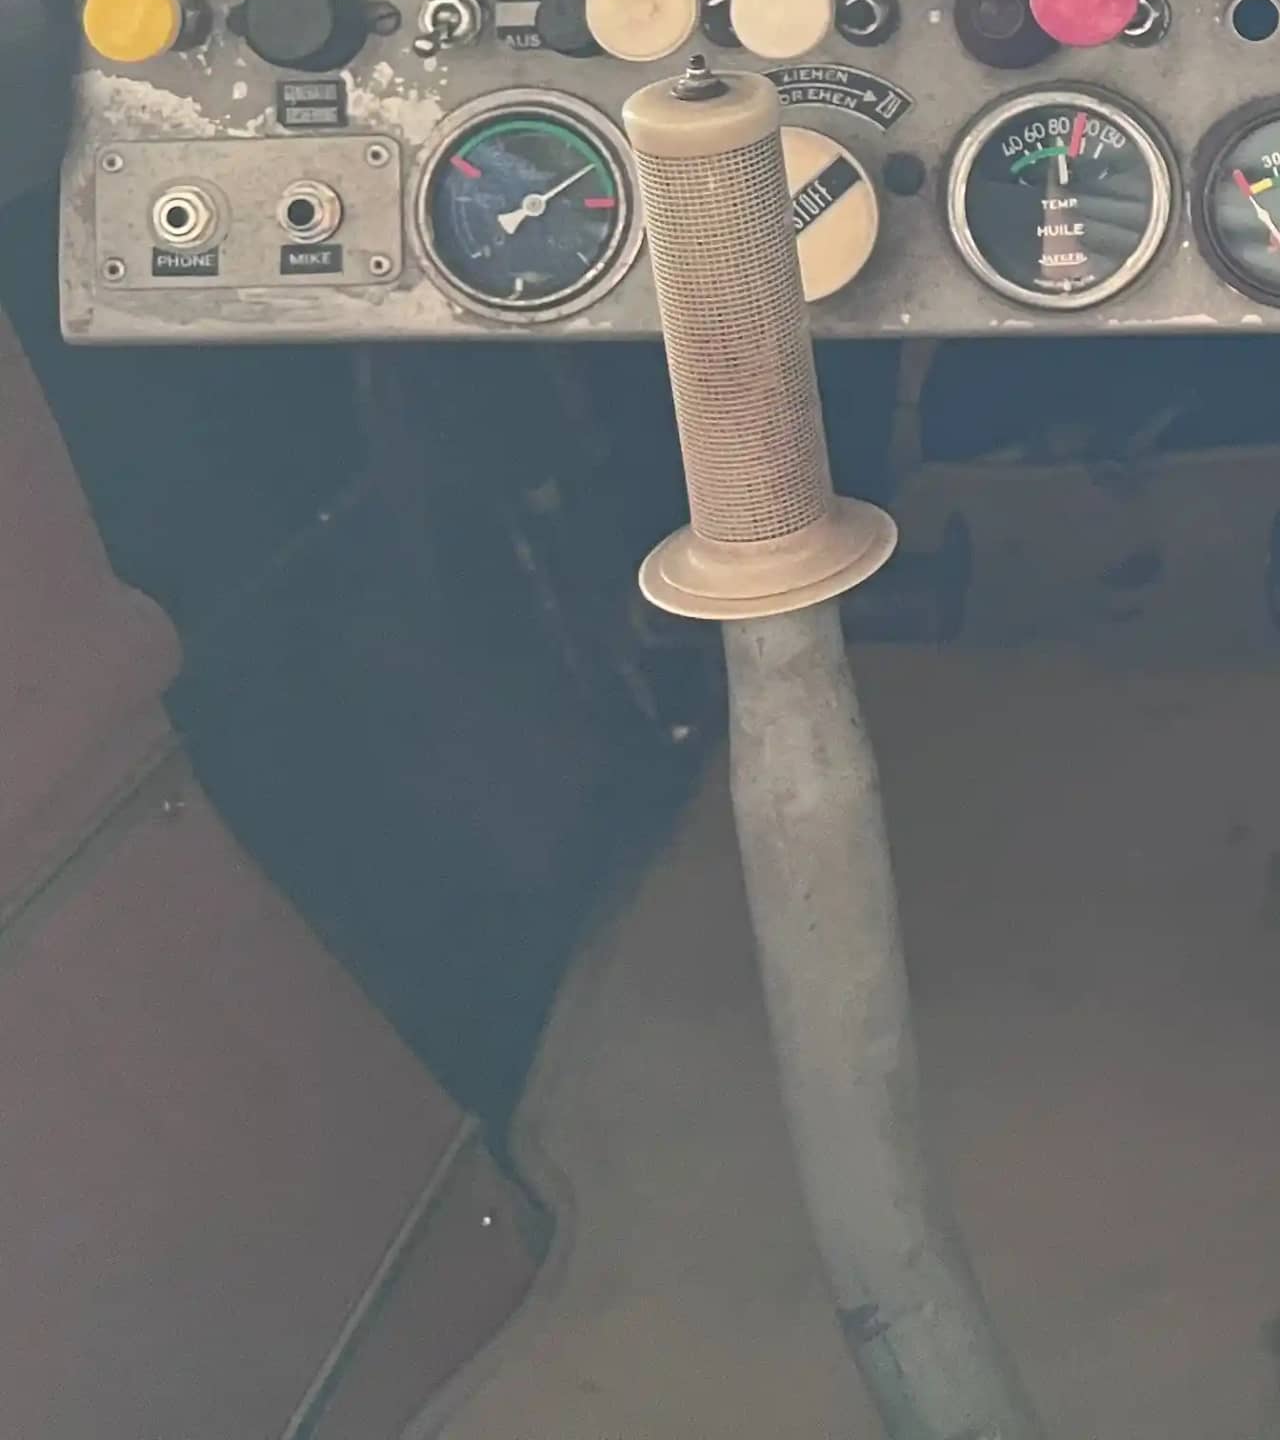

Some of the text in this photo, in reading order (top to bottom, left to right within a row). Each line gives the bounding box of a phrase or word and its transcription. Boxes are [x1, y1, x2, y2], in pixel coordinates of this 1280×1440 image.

[504, 35, 541, 48] AUS
[1048, 117, 1070, 134] 80
[1024, 123, 1046, 143] 60
[1002, 135, 1023, 157] 40
[1036, 223, 1085, 237] HUILE
[157, 254, 216, 268] PHONE
[289, 252, 331, 266] MIKE
